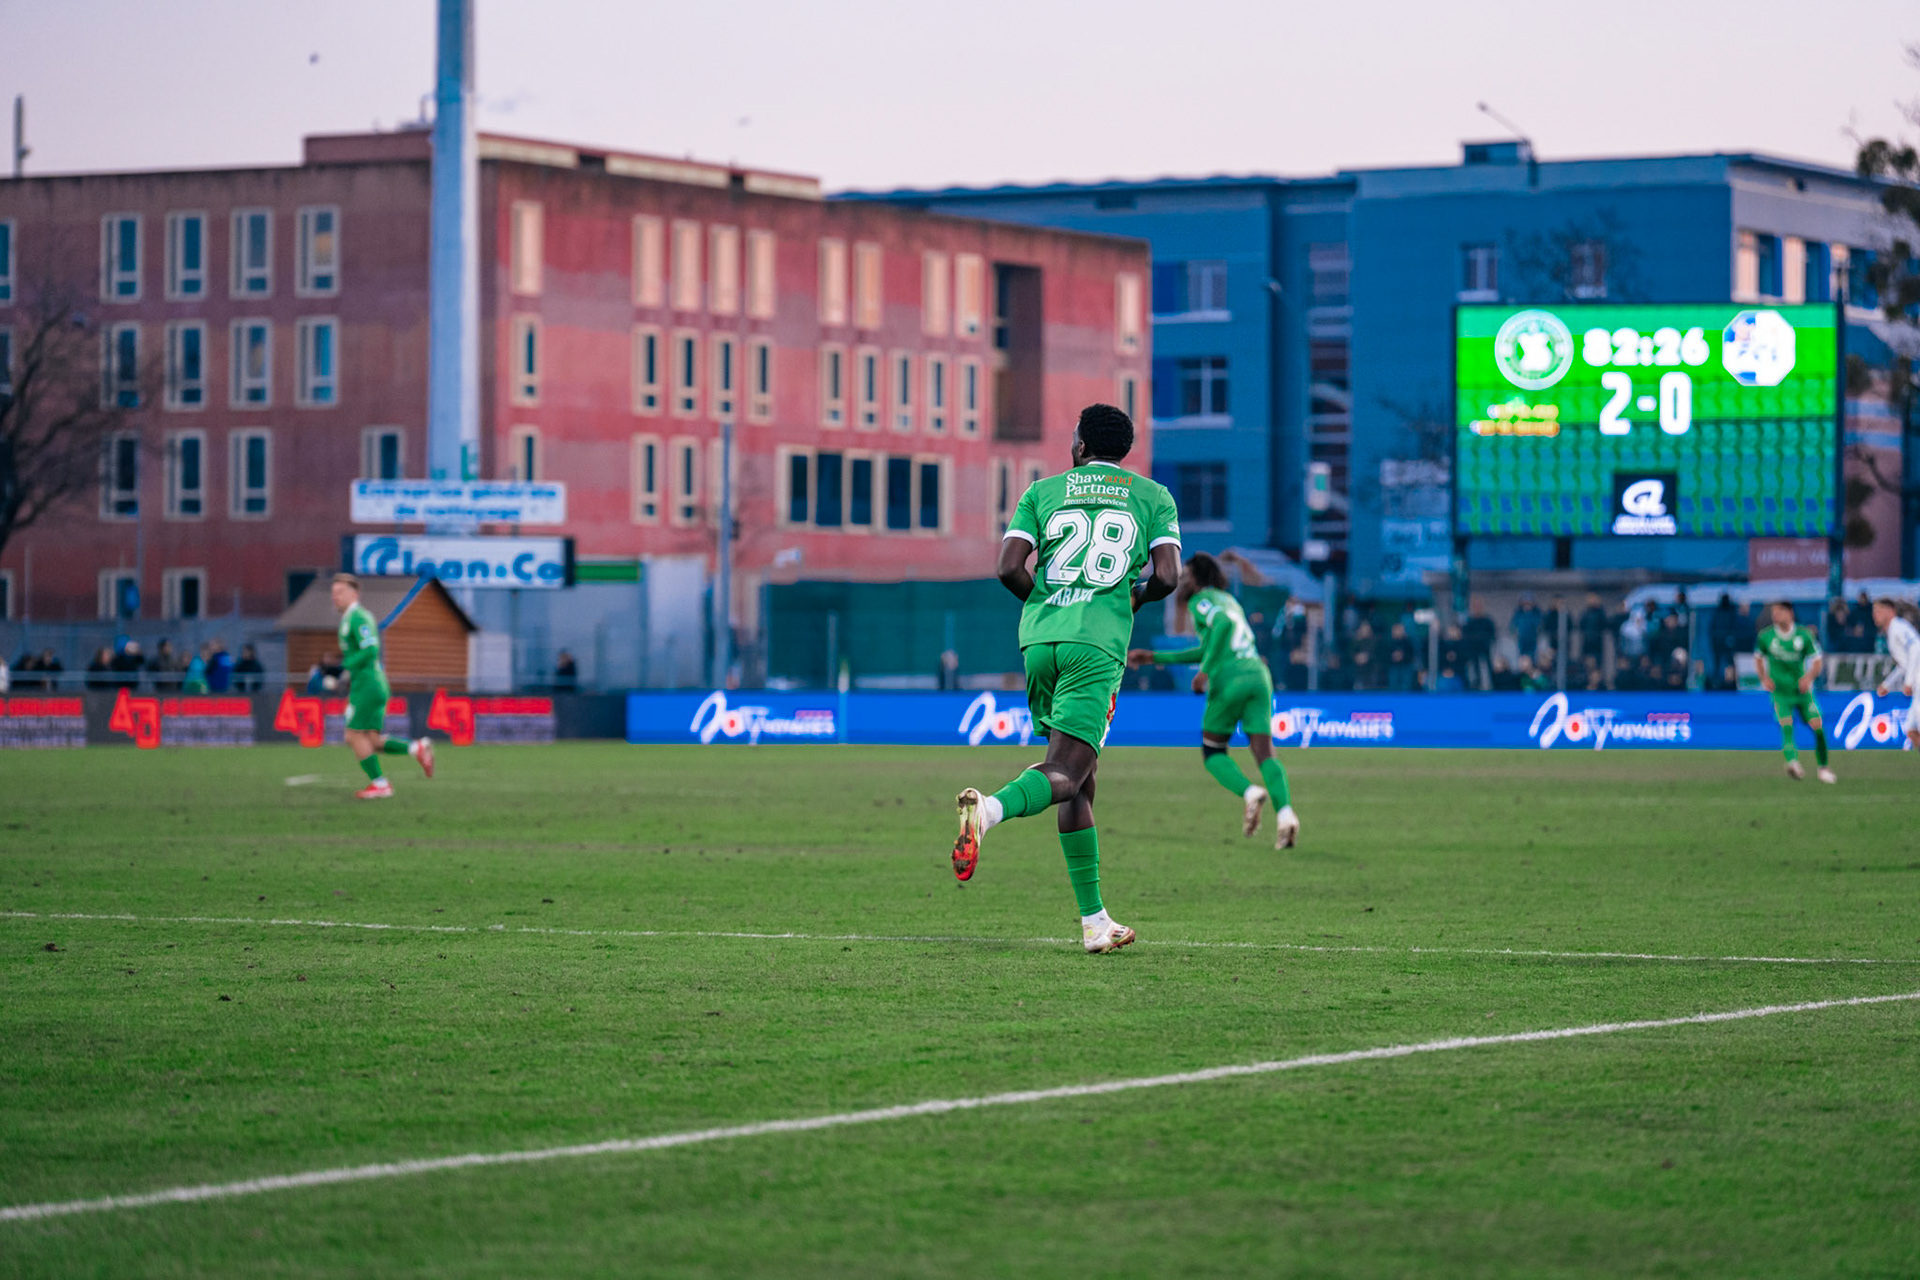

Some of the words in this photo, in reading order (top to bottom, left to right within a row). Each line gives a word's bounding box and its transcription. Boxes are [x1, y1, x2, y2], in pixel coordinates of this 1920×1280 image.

[1583, 327, 1710, 366] 82:26
[1066, 472, 1105, 484] Shaw
[1105, 475, 1132, 486] and
[1065, 482, 1130, 498] Partners
[1063, 497, 1096, 506] Financial
[1096, 497, 1128, 507] Services
[1046, 508, 1139, 587] 28
